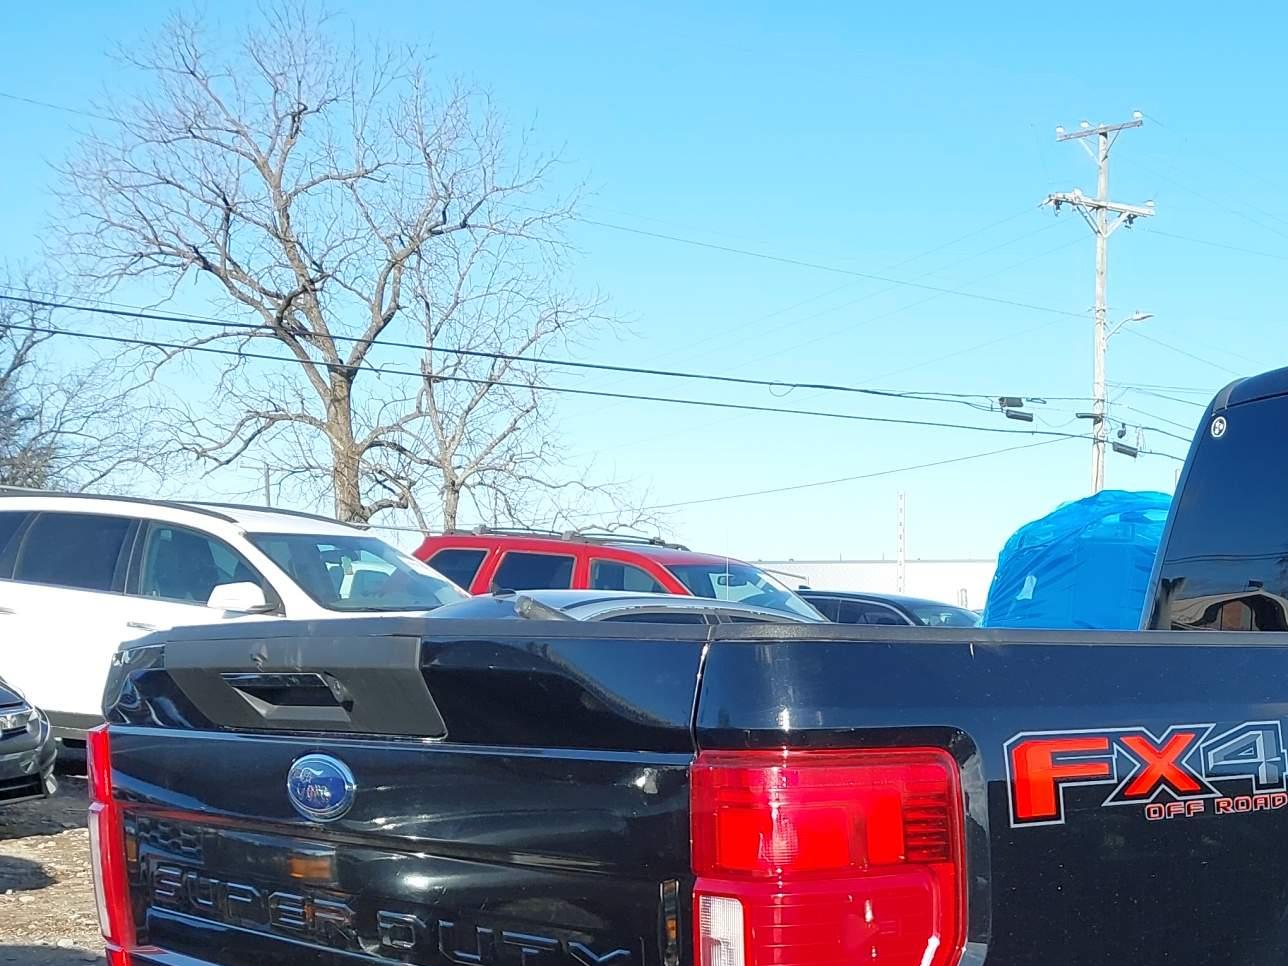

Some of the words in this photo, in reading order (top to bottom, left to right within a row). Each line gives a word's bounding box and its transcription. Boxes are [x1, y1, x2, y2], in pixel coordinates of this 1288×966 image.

[1003, 720, 1288, 828] FX4
[1145, 800, 1205, 821] OFF
[1215, 793, 1288, 815] ROAD
[152, 864, 358, 946] SUPER
